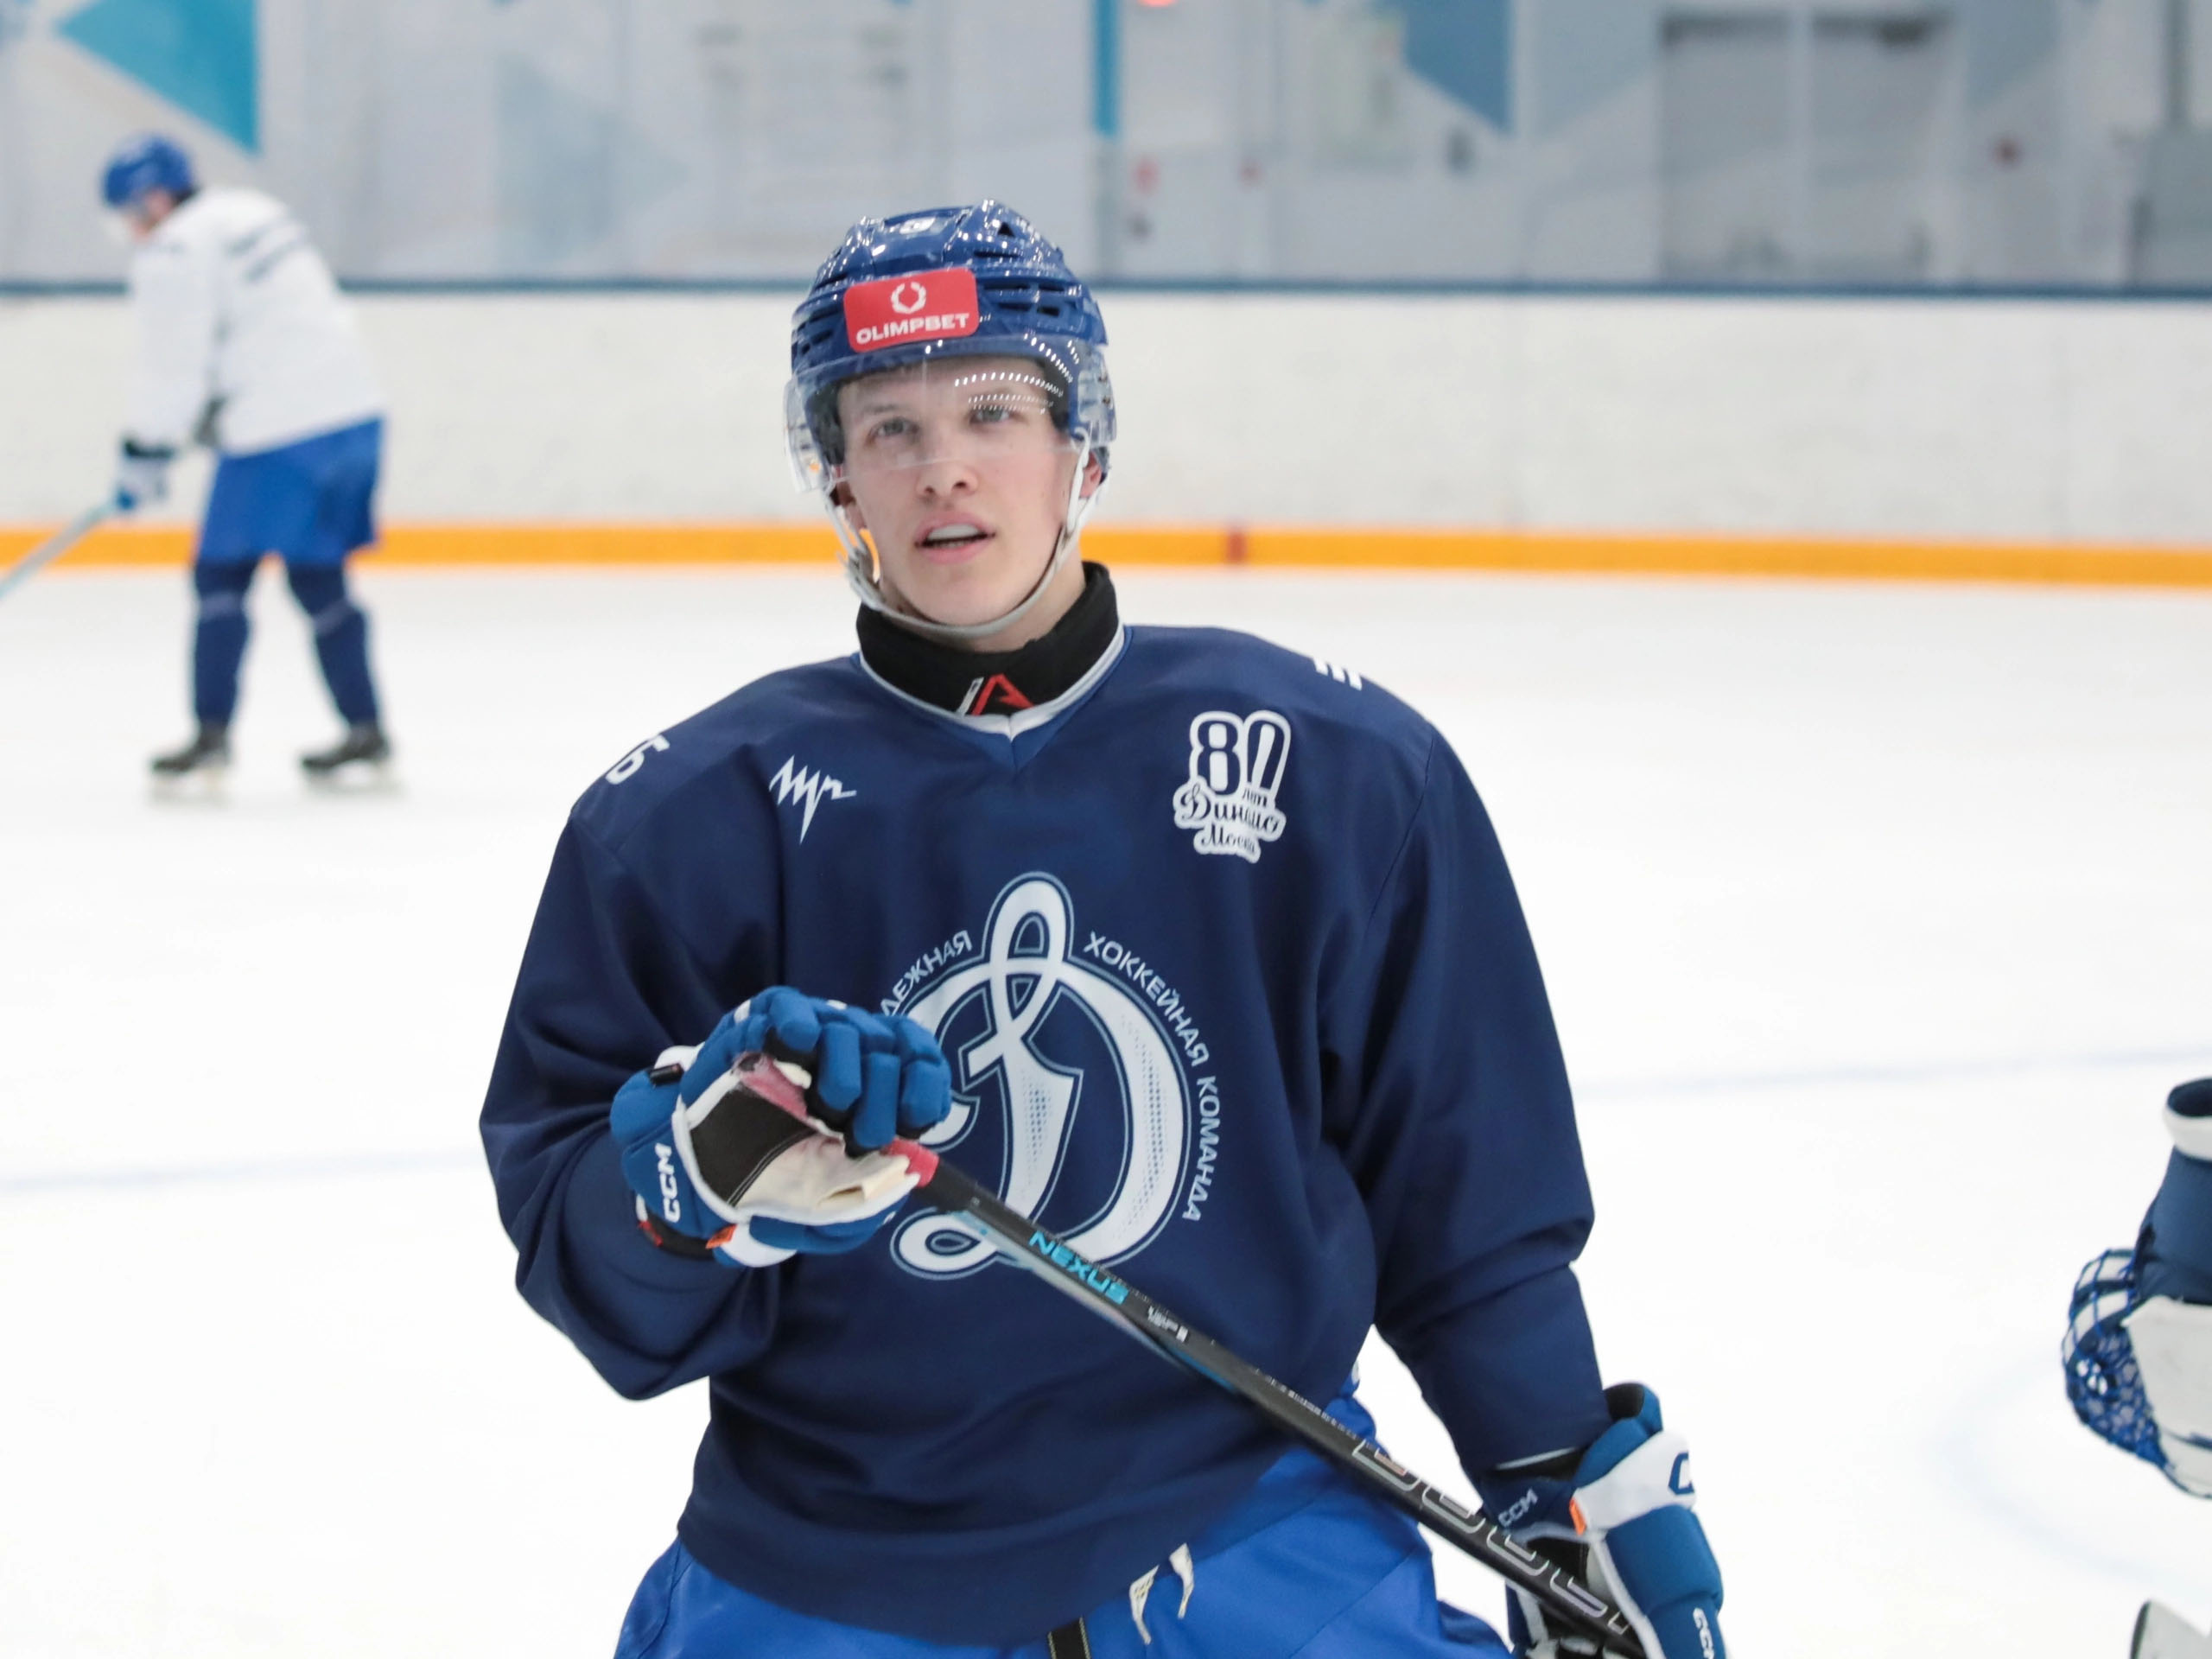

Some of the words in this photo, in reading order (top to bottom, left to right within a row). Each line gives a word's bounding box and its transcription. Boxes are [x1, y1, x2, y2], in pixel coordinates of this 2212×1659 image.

[856, 313, 969, 345] OLIMPBET
[1191, 711, 1290, 797] 80
[880, 930, 973, 1017] ДЕЖНАЯ
[1084, 931, 1210, 1067] ХОККЕЙНАЯ
[1182, 1076, 1221, 1221] КОМАНДА
[655, 1142, 681, 1224] CCM
[1029, 1230, 1128, 1306] NEXUS
[1497, 1488, 1538, 1529] CCM
